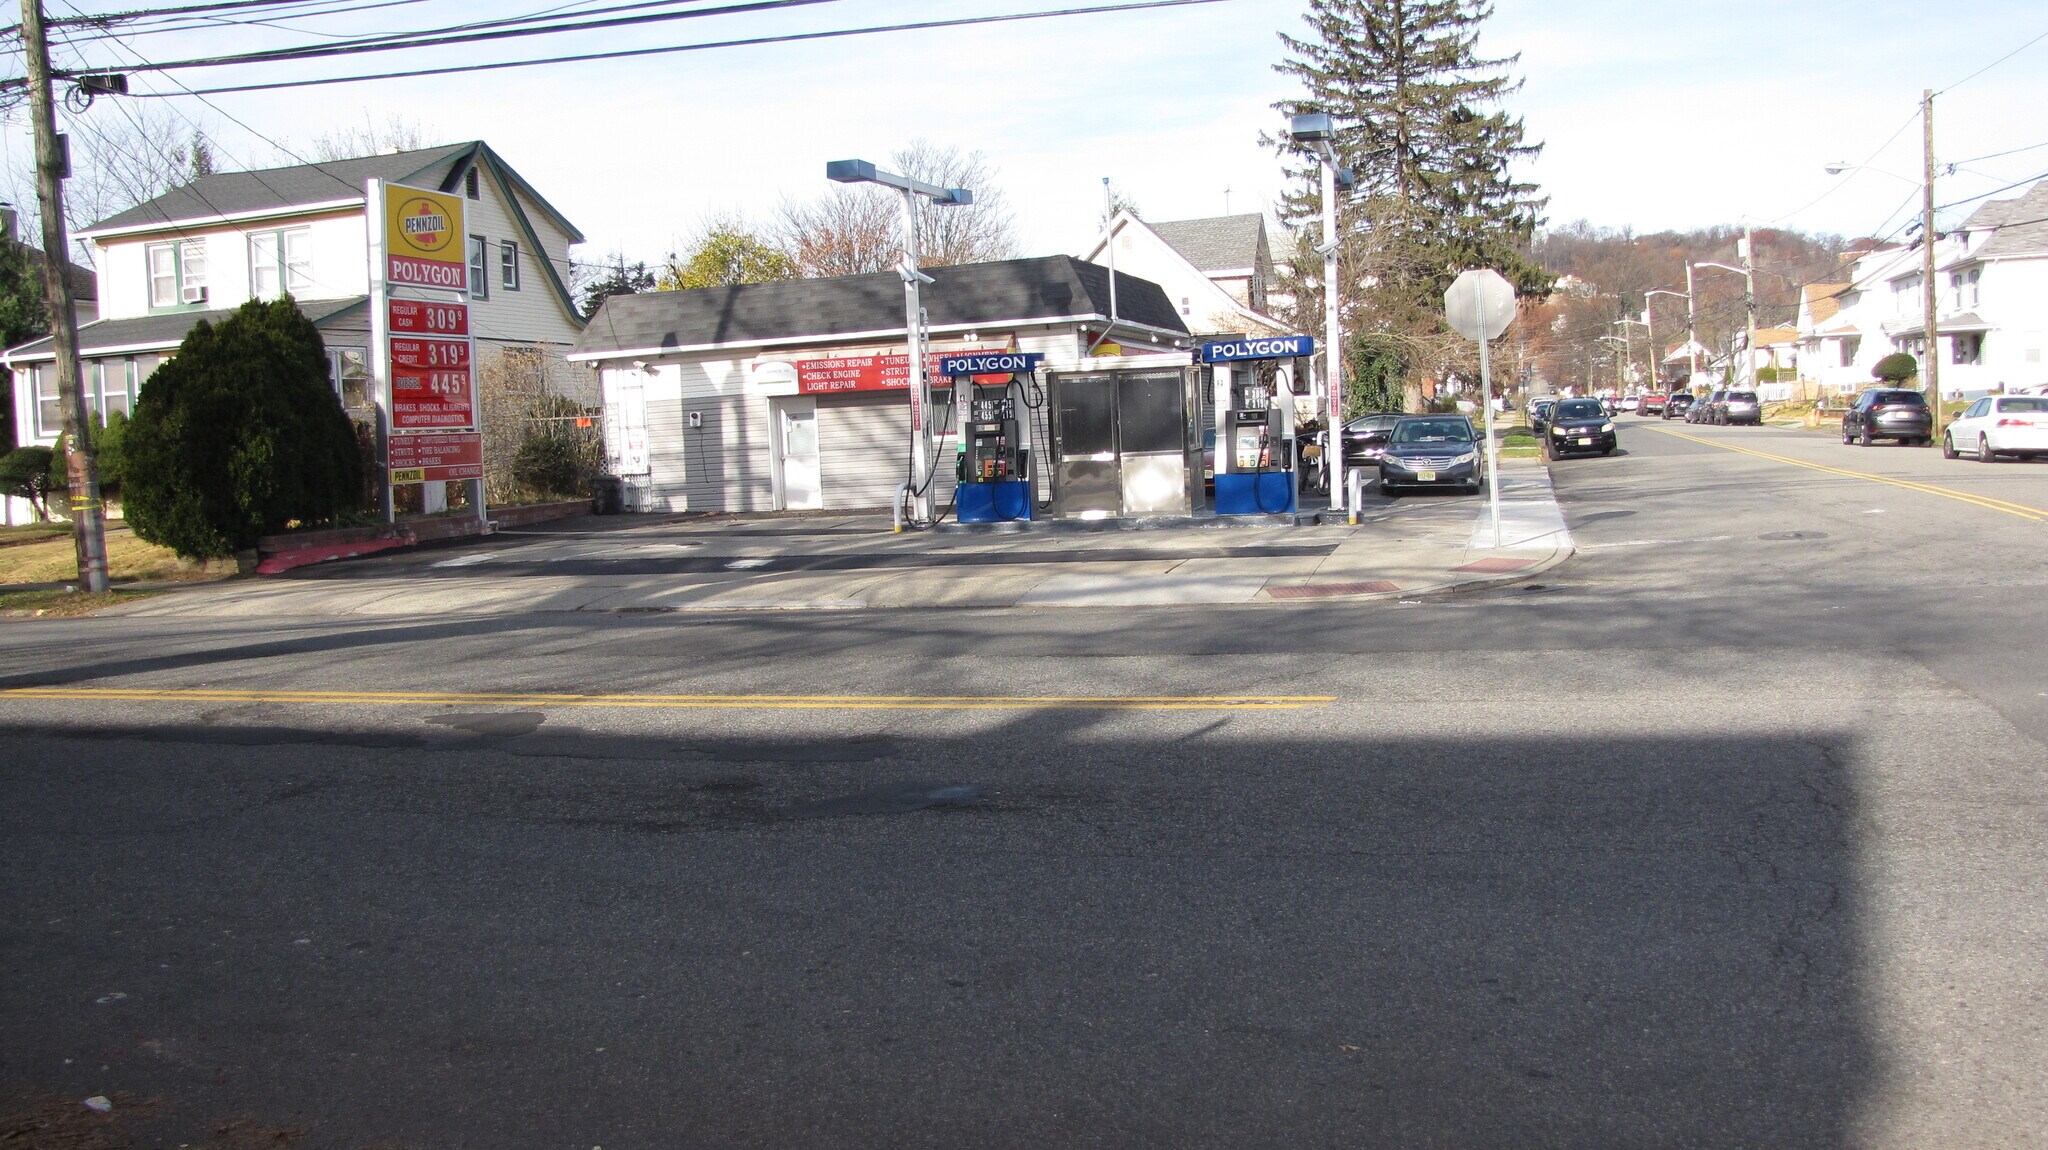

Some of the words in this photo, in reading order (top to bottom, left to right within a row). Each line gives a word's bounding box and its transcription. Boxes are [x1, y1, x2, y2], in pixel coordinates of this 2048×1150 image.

[405, 215, 445, 234] PENNZOIL
[393, 261, 461, 285] POLYGON
[392, 305, 418, 316] REGULAR
[398, 317, 414, 327] CASH
[394, 342, 420, 352] REGULAR
[1212, 340, 1298, 358] POLYGON
[398, 354, 418, 364] CREDIT
[805, 359, 846, 370] EMISSIONS
[847, 358, 873, 368] REPAIR
[885, 356, 910, 365] TUNEU
[947, 356, 1026, 372] POLYGON
[806, 371, 832, 381] CHECK
[833, 369, 861, 379] ENGINE
[396, 376, 423, 390] DIESEL
[806, 382, 829, 391] LIGHT
[830, 380, 856, 390] REPAIR
[402, 414, 431, 424] COMPUTER
